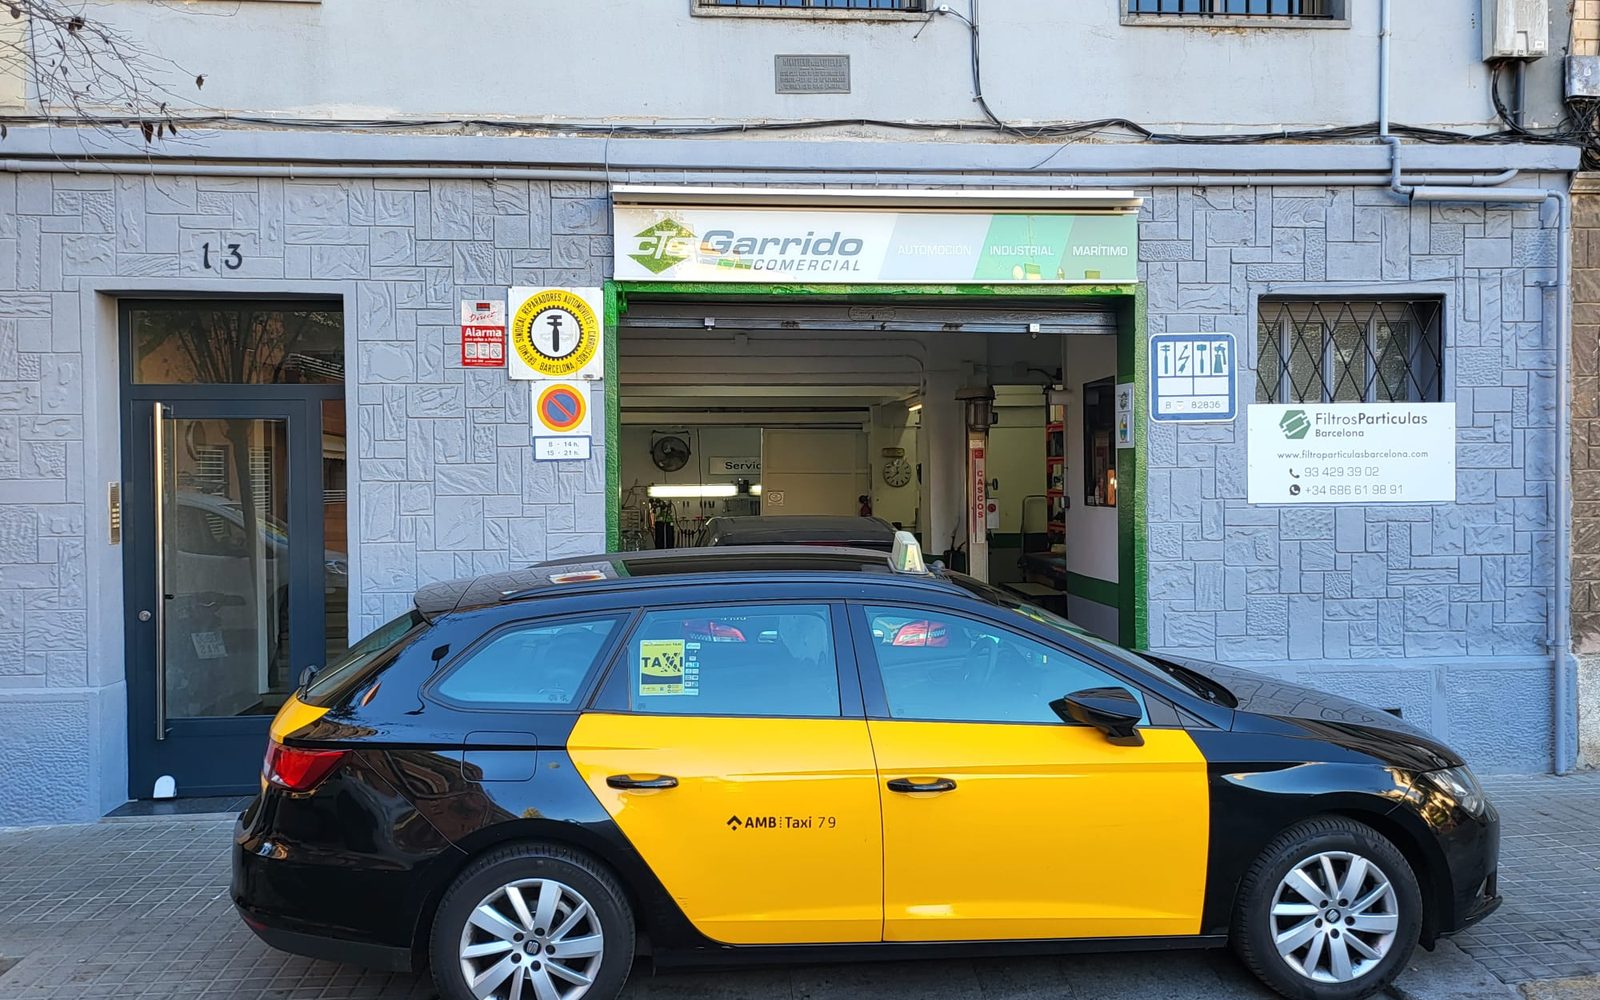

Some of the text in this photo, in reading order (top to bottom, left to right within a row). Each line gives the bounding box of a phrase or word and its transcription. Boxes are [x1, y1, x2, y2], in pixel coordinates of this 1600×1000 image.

[700, 230, 864, 256] Garrido
[1072, 243, 1128, 256] MARÍTIMO
[990, 245, 1055, 256] INDUSTRIAL
[753, 258, 861, 271] COMERCIAL
[522, 293, 562, 315] REPARADORES
[563, 295, 594, 324] AUTOMOVILES
[465, 327, 502, 337] Alarma
[514, 317, 525, 343] SINDICAL
[519, 344, 537, 365] GREMIO
[539, 362, 575, 373] BARCELONA
[1315, 412, 1428, 425] FiltrosParticulas
[1315, 428, 1365, 438] Barcelona
[1277, 449, 1429, 461] www.filtroparticulasbarcelona.com
[1304, 467, 1380, 477] 93 429 39 02
[1305, 485, 1404, 496] +34 686 61 98 91
[641, 652, 683, 673] TAXI
[745, 816, 836, 829] AMB Taxi 79
